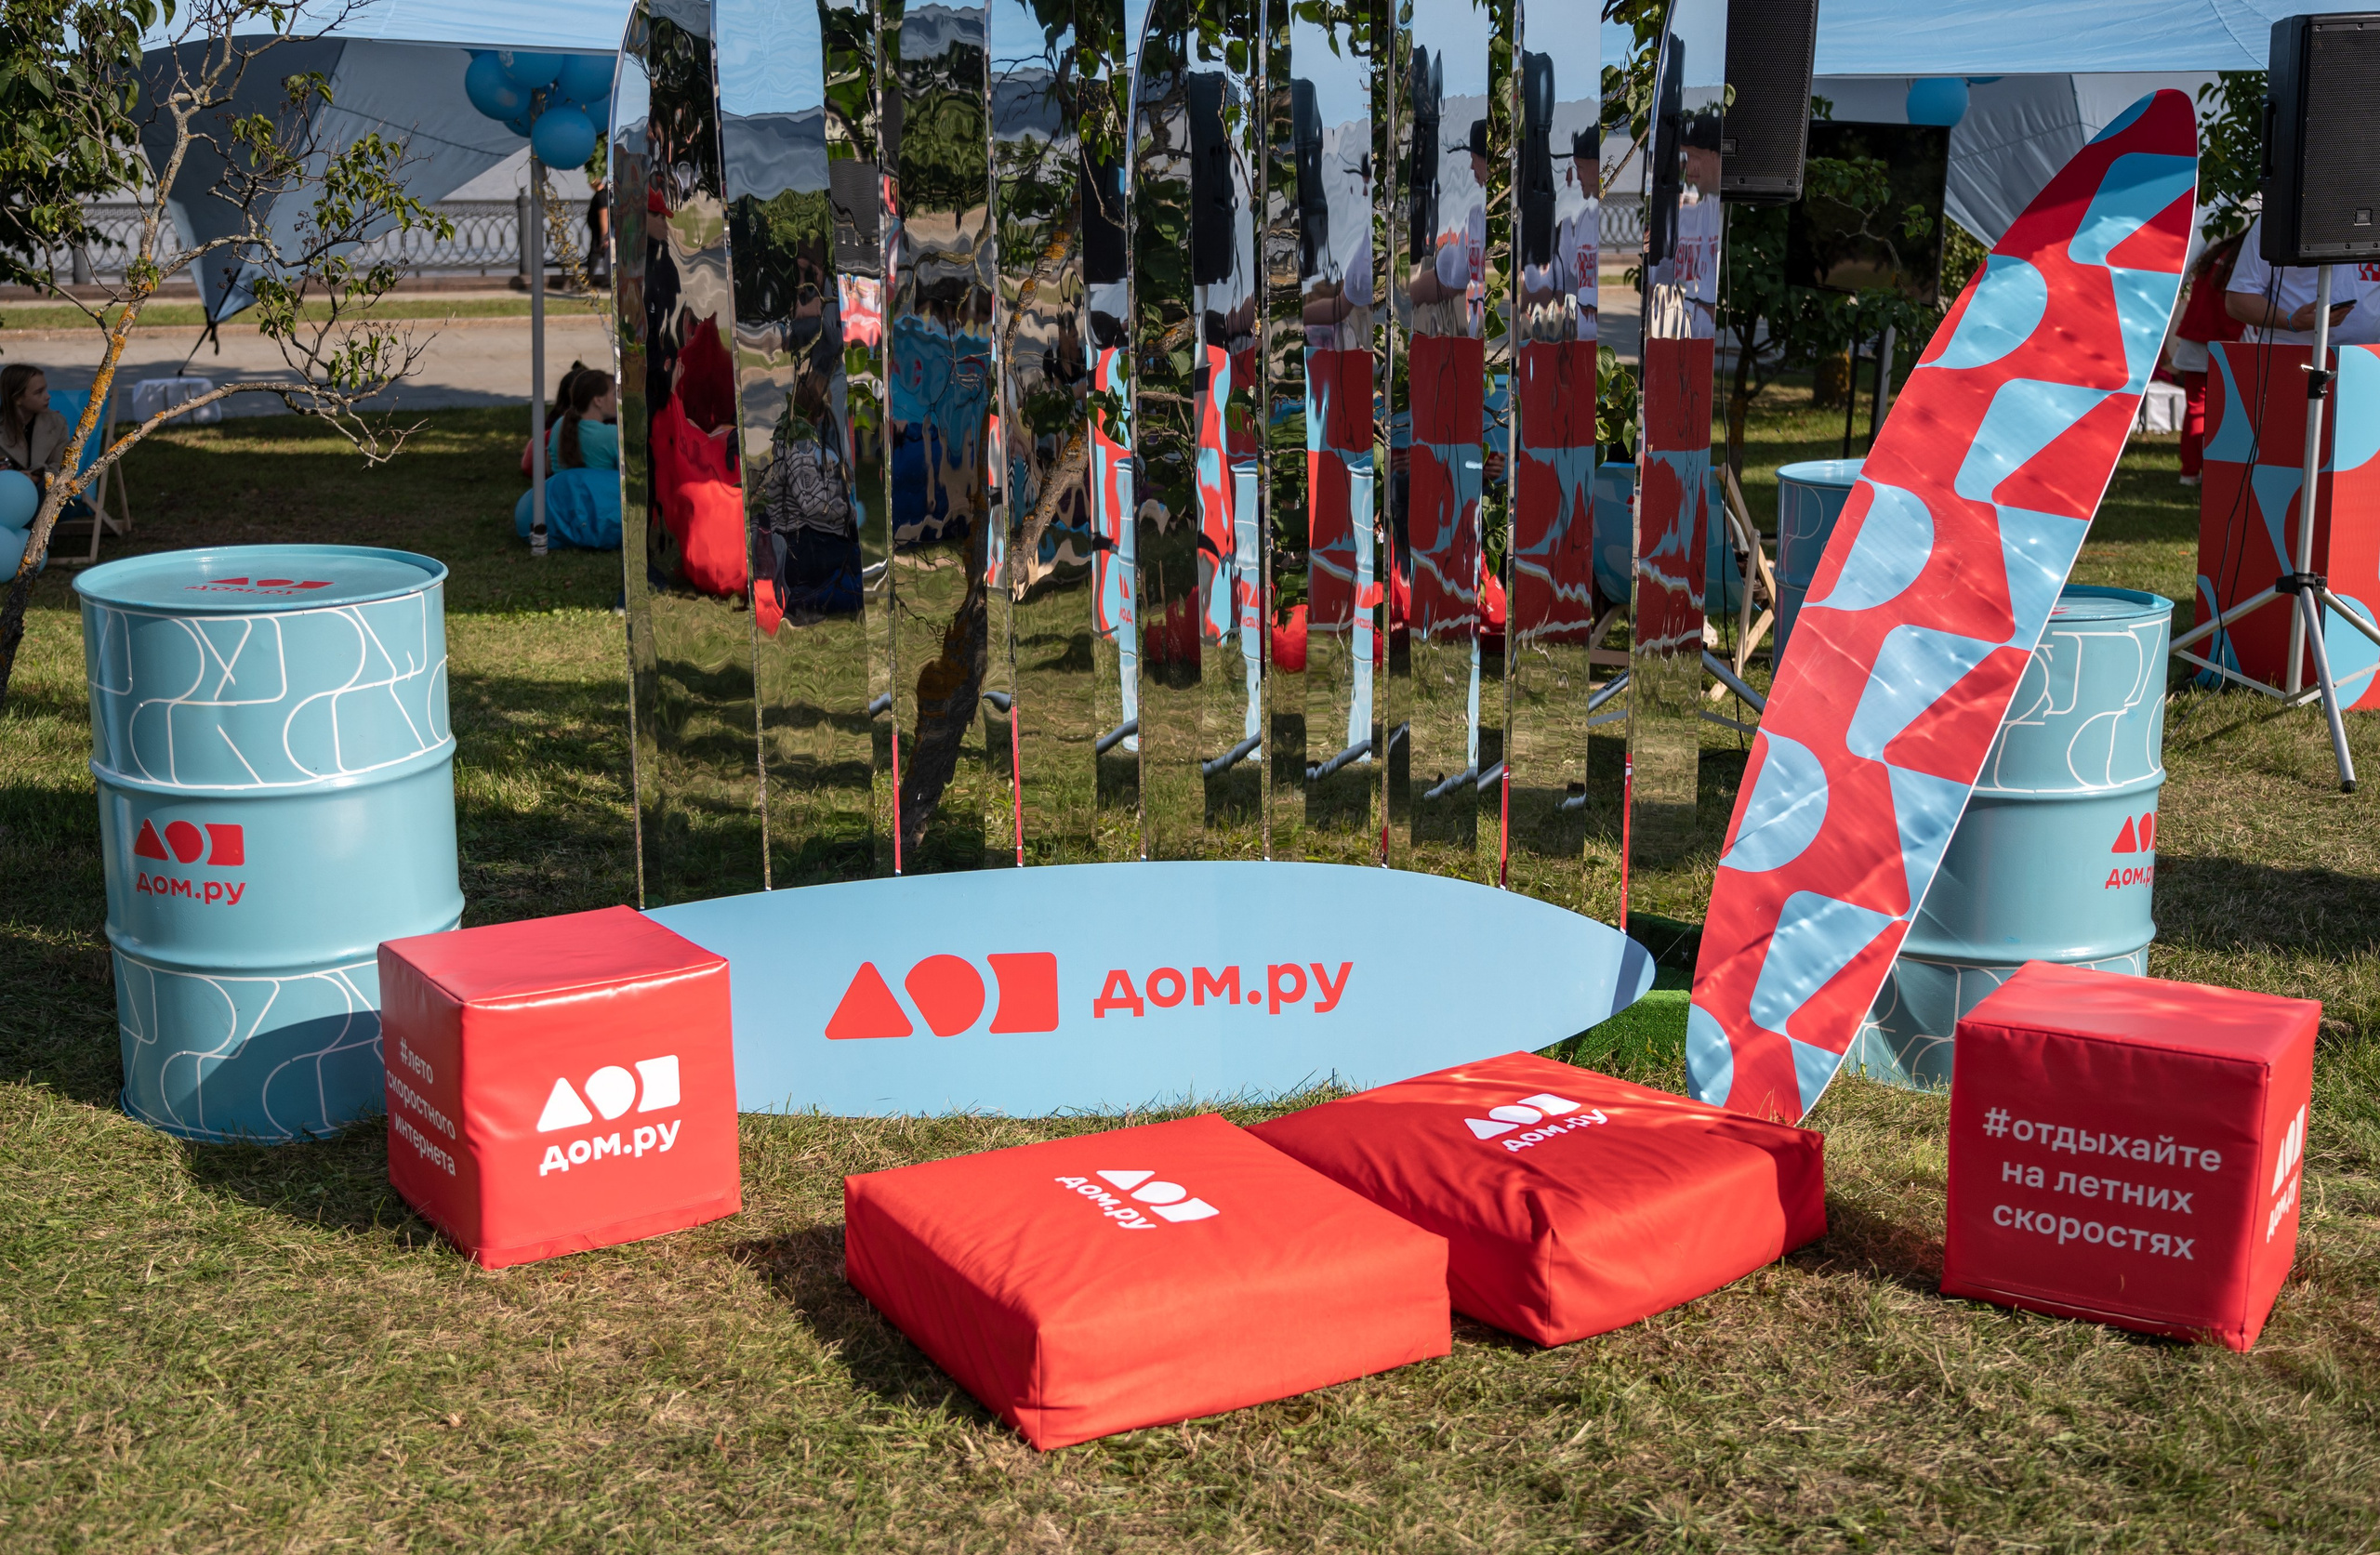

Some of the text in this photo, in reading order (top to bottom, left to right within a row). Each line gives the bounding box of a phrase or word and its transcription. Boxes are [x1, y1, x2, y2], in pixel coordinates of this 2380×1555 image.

[137, 872, 246, 906] дом.ру
[1093, 961, 1355, 1019] дом.ру
[400, 1036, 433, 1085] #лето
[387, 1069, 456, 1140] скоростного
[1501, 1108, 1608, 1153] дом.ру
[394, 1112, 456, 1177] интернета
[539, 1119, 681, 1177] дом.ру
[1982, 1106, 2223, 1172] #отдыхайте
[1054, 1176, 1157, 1230] дом.ру
[2002, 1161, 2195, 1215] на летних
[1992, 1205, 2196, 1261] скоростях
